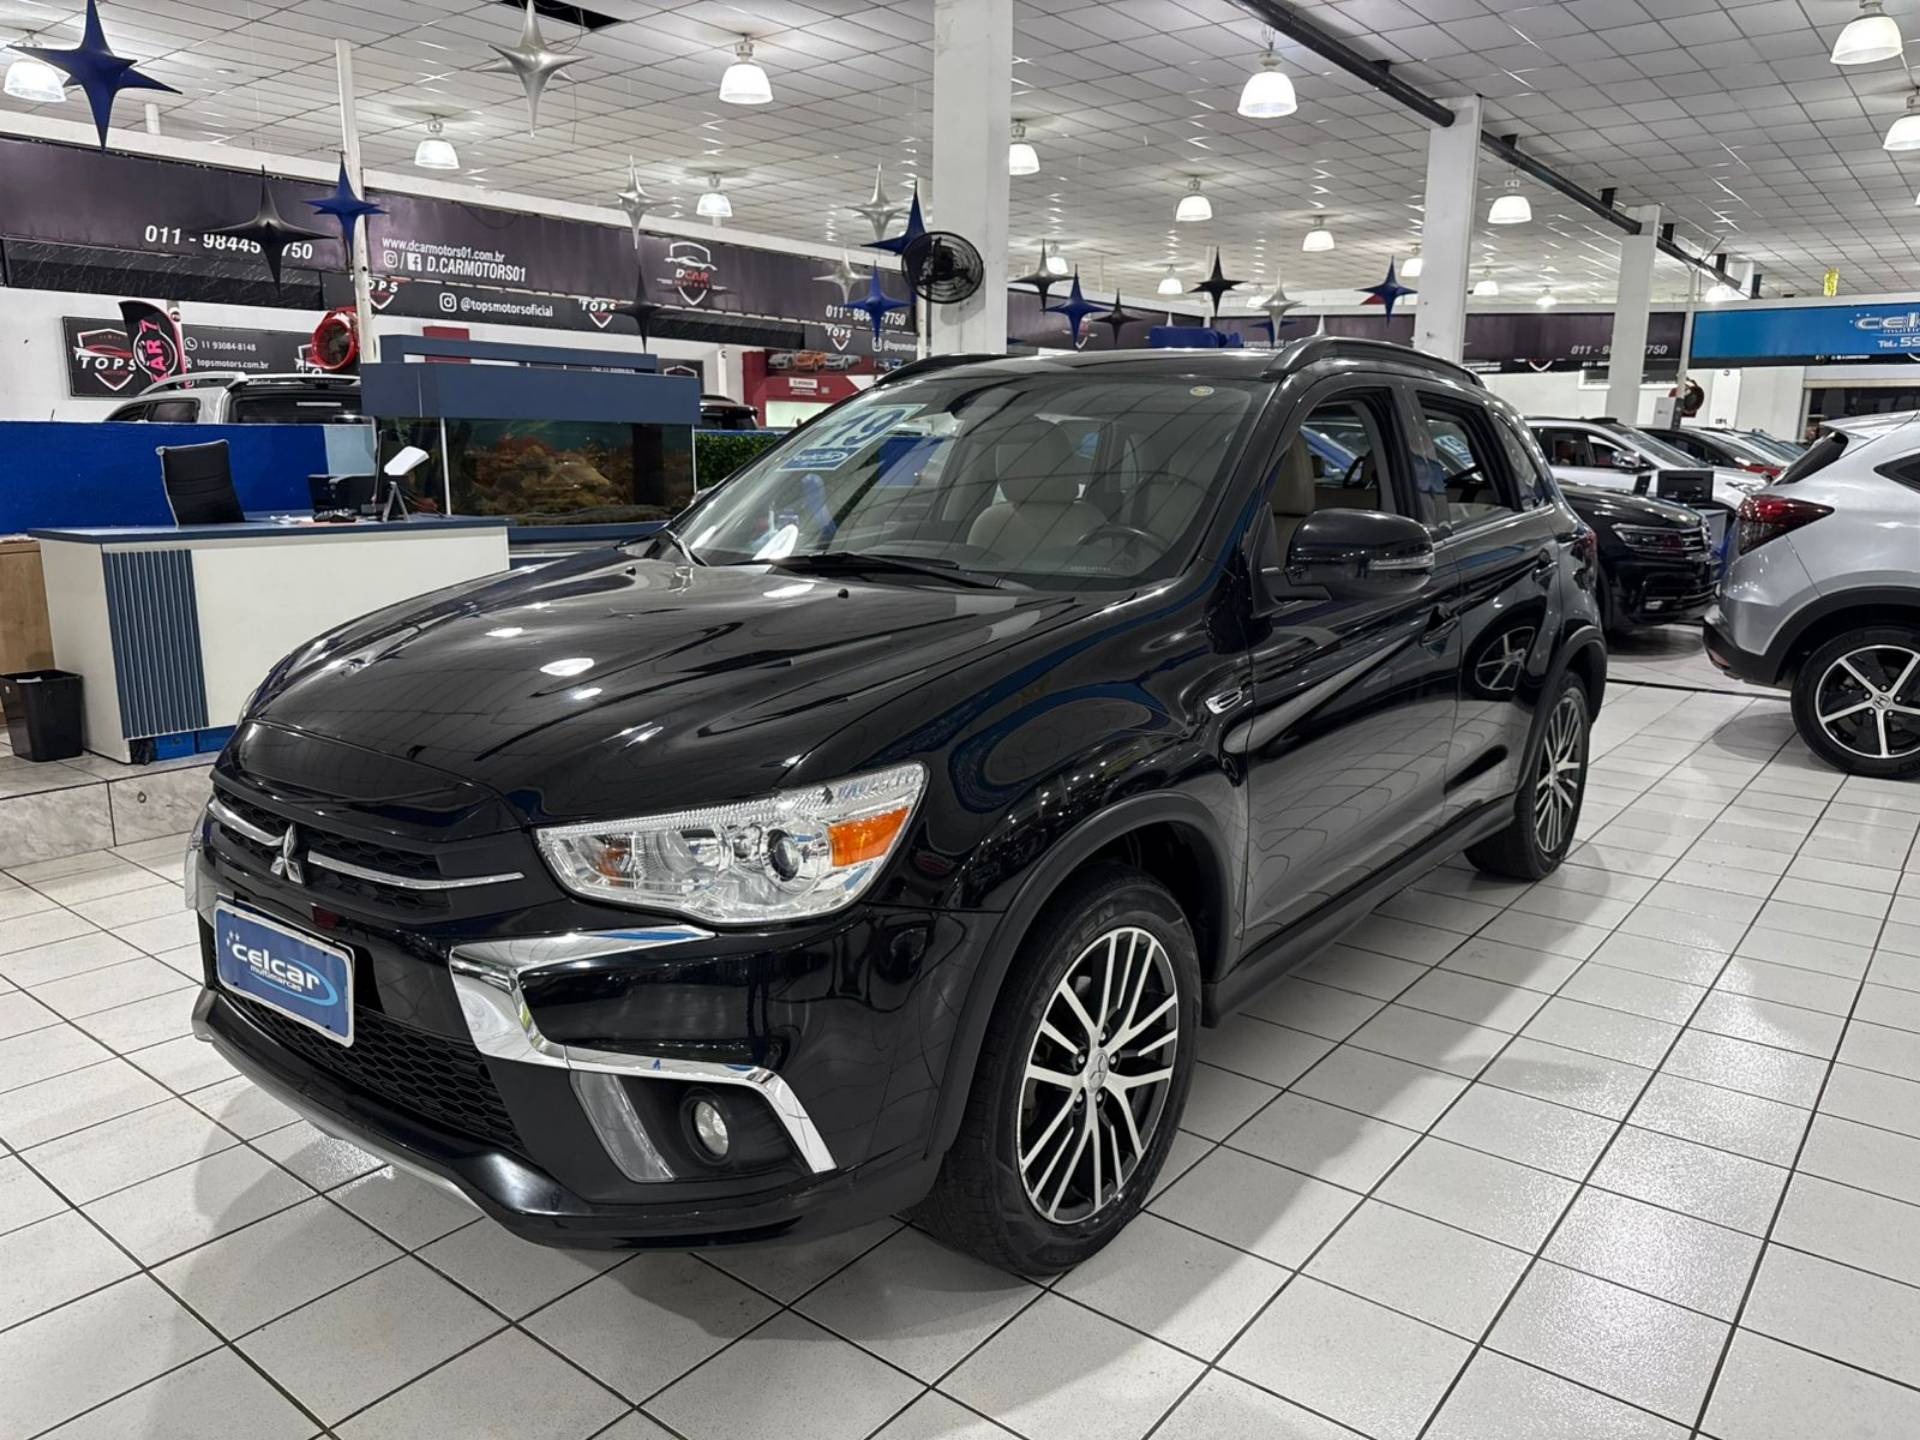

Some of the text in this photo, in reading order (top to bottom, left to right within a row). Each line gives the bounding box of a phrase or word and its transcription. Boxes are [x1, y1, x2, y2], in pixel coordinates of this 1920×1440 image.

[145, 225, 182, 245] 011
[382, 237, 505, 263] www.dcarmotors01.com.br
[427, 256, 527, 282] D.CARMOTORS01
[675, 268, 709, 282] DCAR
[368, 280, 399, 294] OPS
[460, 297, 553, 318] @topsmotorsoficial
[825, 304, 844, 319] 011
[1854, 312, 1920, 330] cel
[826, 326, 852, 338] TOPS
[201, 340, 210, 349] 11
[80, 356, 137, 371] TOPS
[196, 358, 269, 370] topsmotors.com.br
[231, 943, 321, 991] celcar
